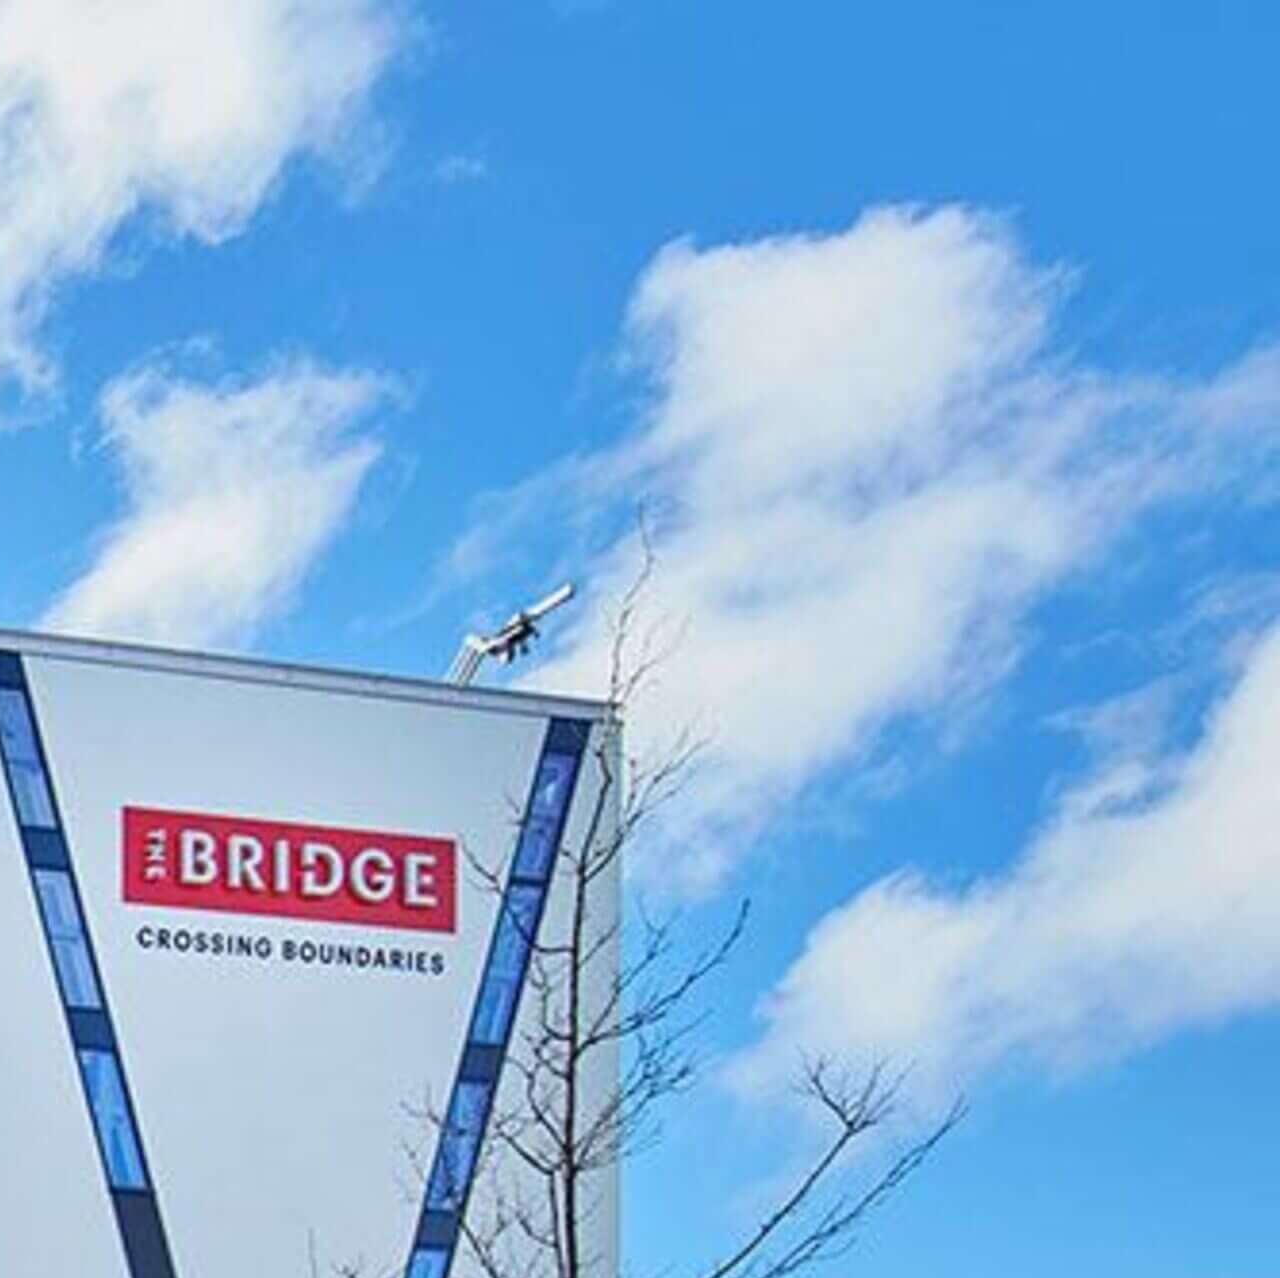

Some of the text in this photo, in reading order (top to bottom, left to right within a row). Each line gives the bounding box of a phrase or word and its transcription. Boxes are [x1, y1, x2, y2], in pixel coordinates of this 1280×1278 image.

[179, 828, 438, 907] BRIDGE
[136, 926, 445, 974] CROSSING BOUNDARIES
